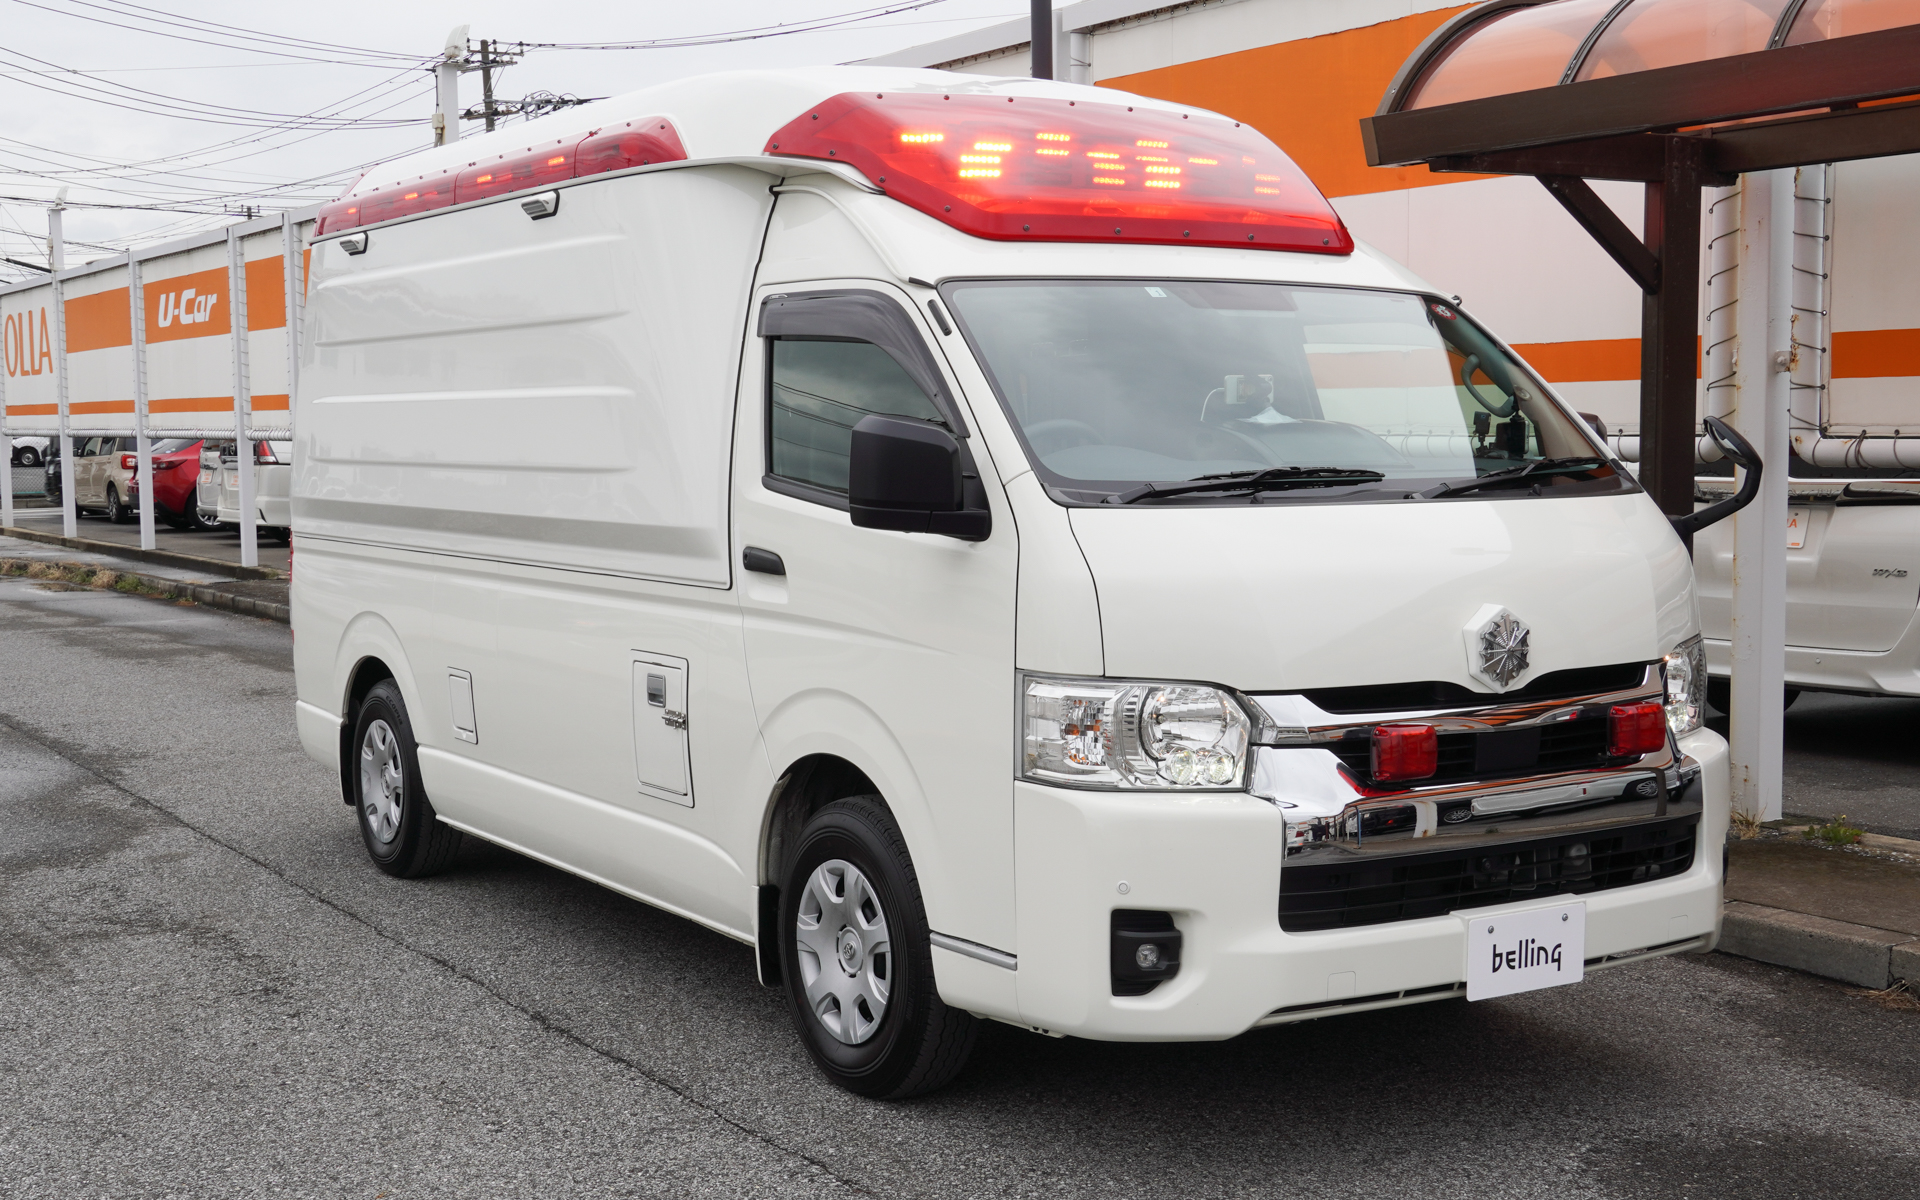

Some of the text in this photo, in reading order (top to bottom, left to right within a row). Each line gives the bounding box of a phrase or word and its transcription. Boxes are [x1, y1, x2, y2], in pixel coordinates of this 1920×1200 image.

[158, 288, 217, 328] U-Car
[4, 306, 53, 378] OLLA
[1492, 938, 1562, 973] belling
